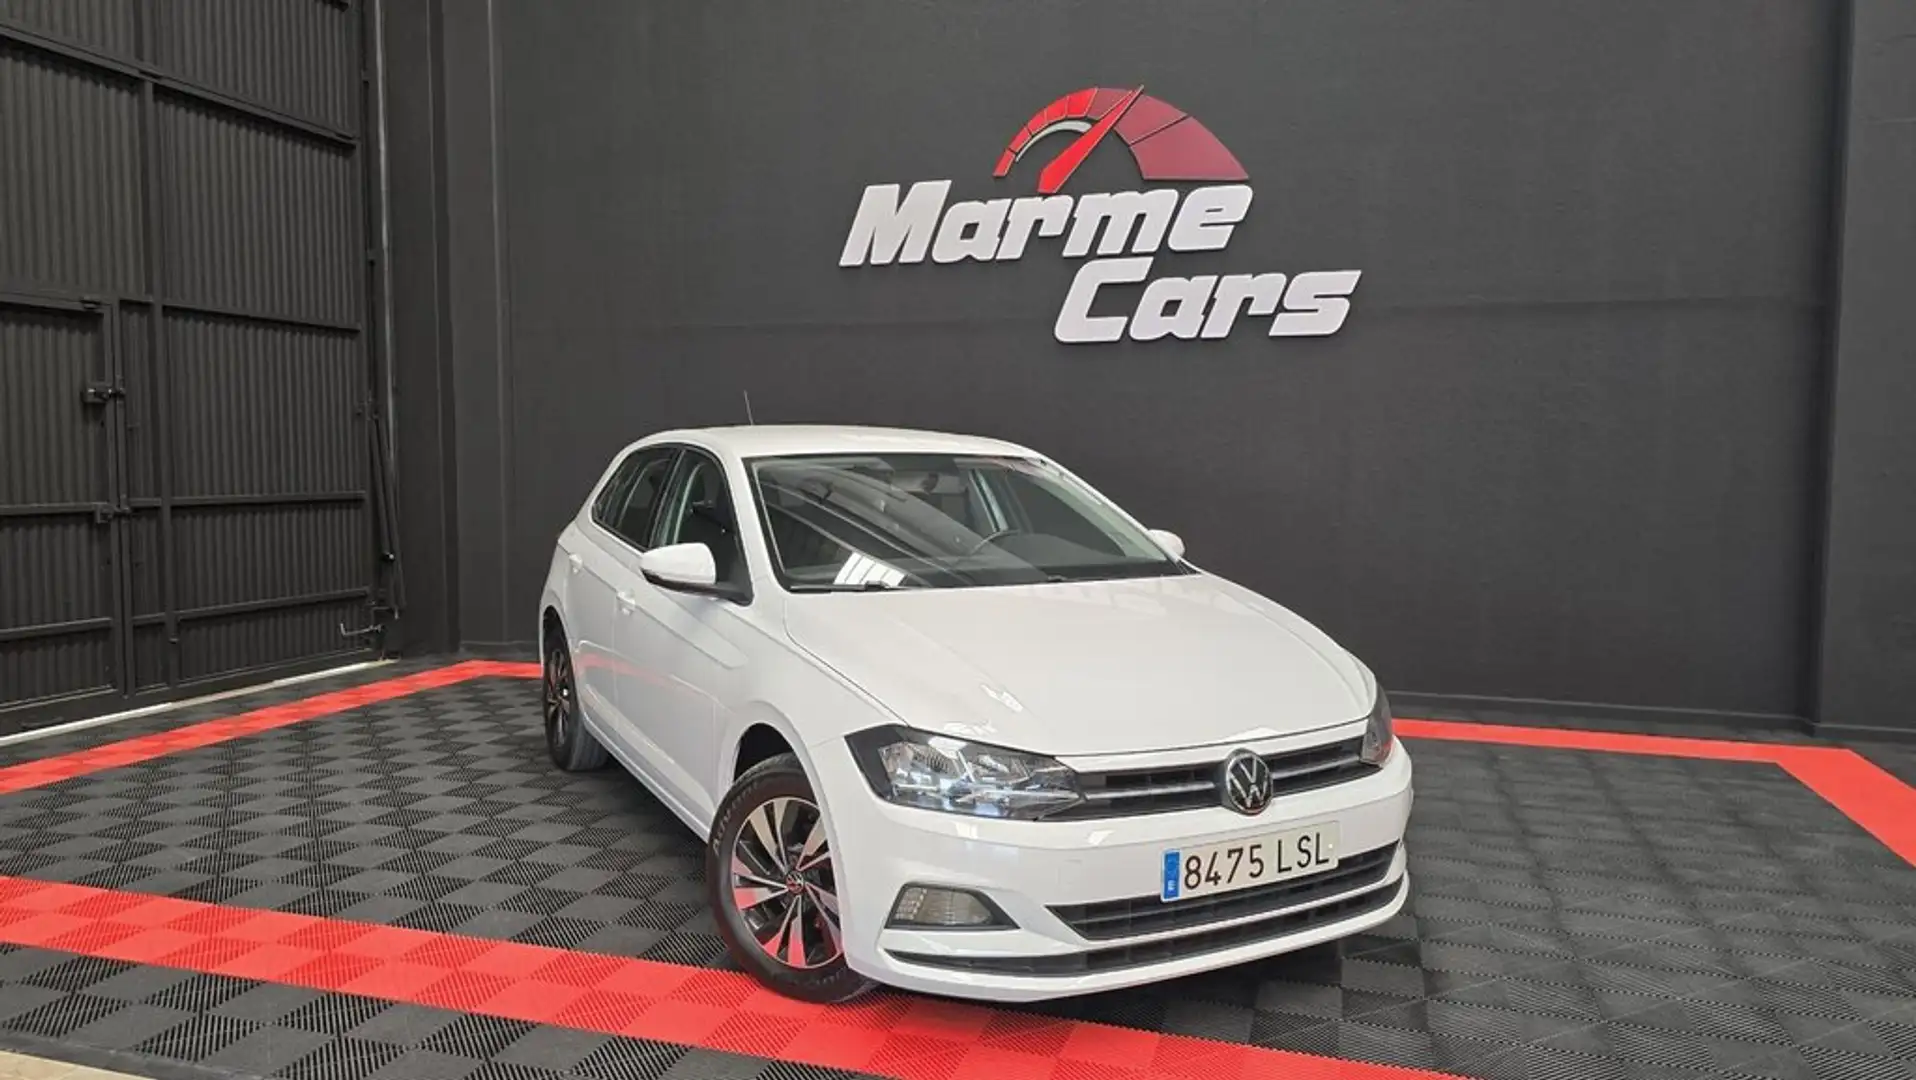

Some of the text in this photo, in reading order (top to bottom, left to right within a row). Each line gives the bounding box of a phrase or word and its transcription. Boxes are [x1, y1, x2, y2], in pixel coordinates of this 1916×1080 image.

[839, 180, 1253, 266] Marme
[1054, 257, 1362, 343] Cars
[1184, 832, 1329, 890] 8475 LSL
